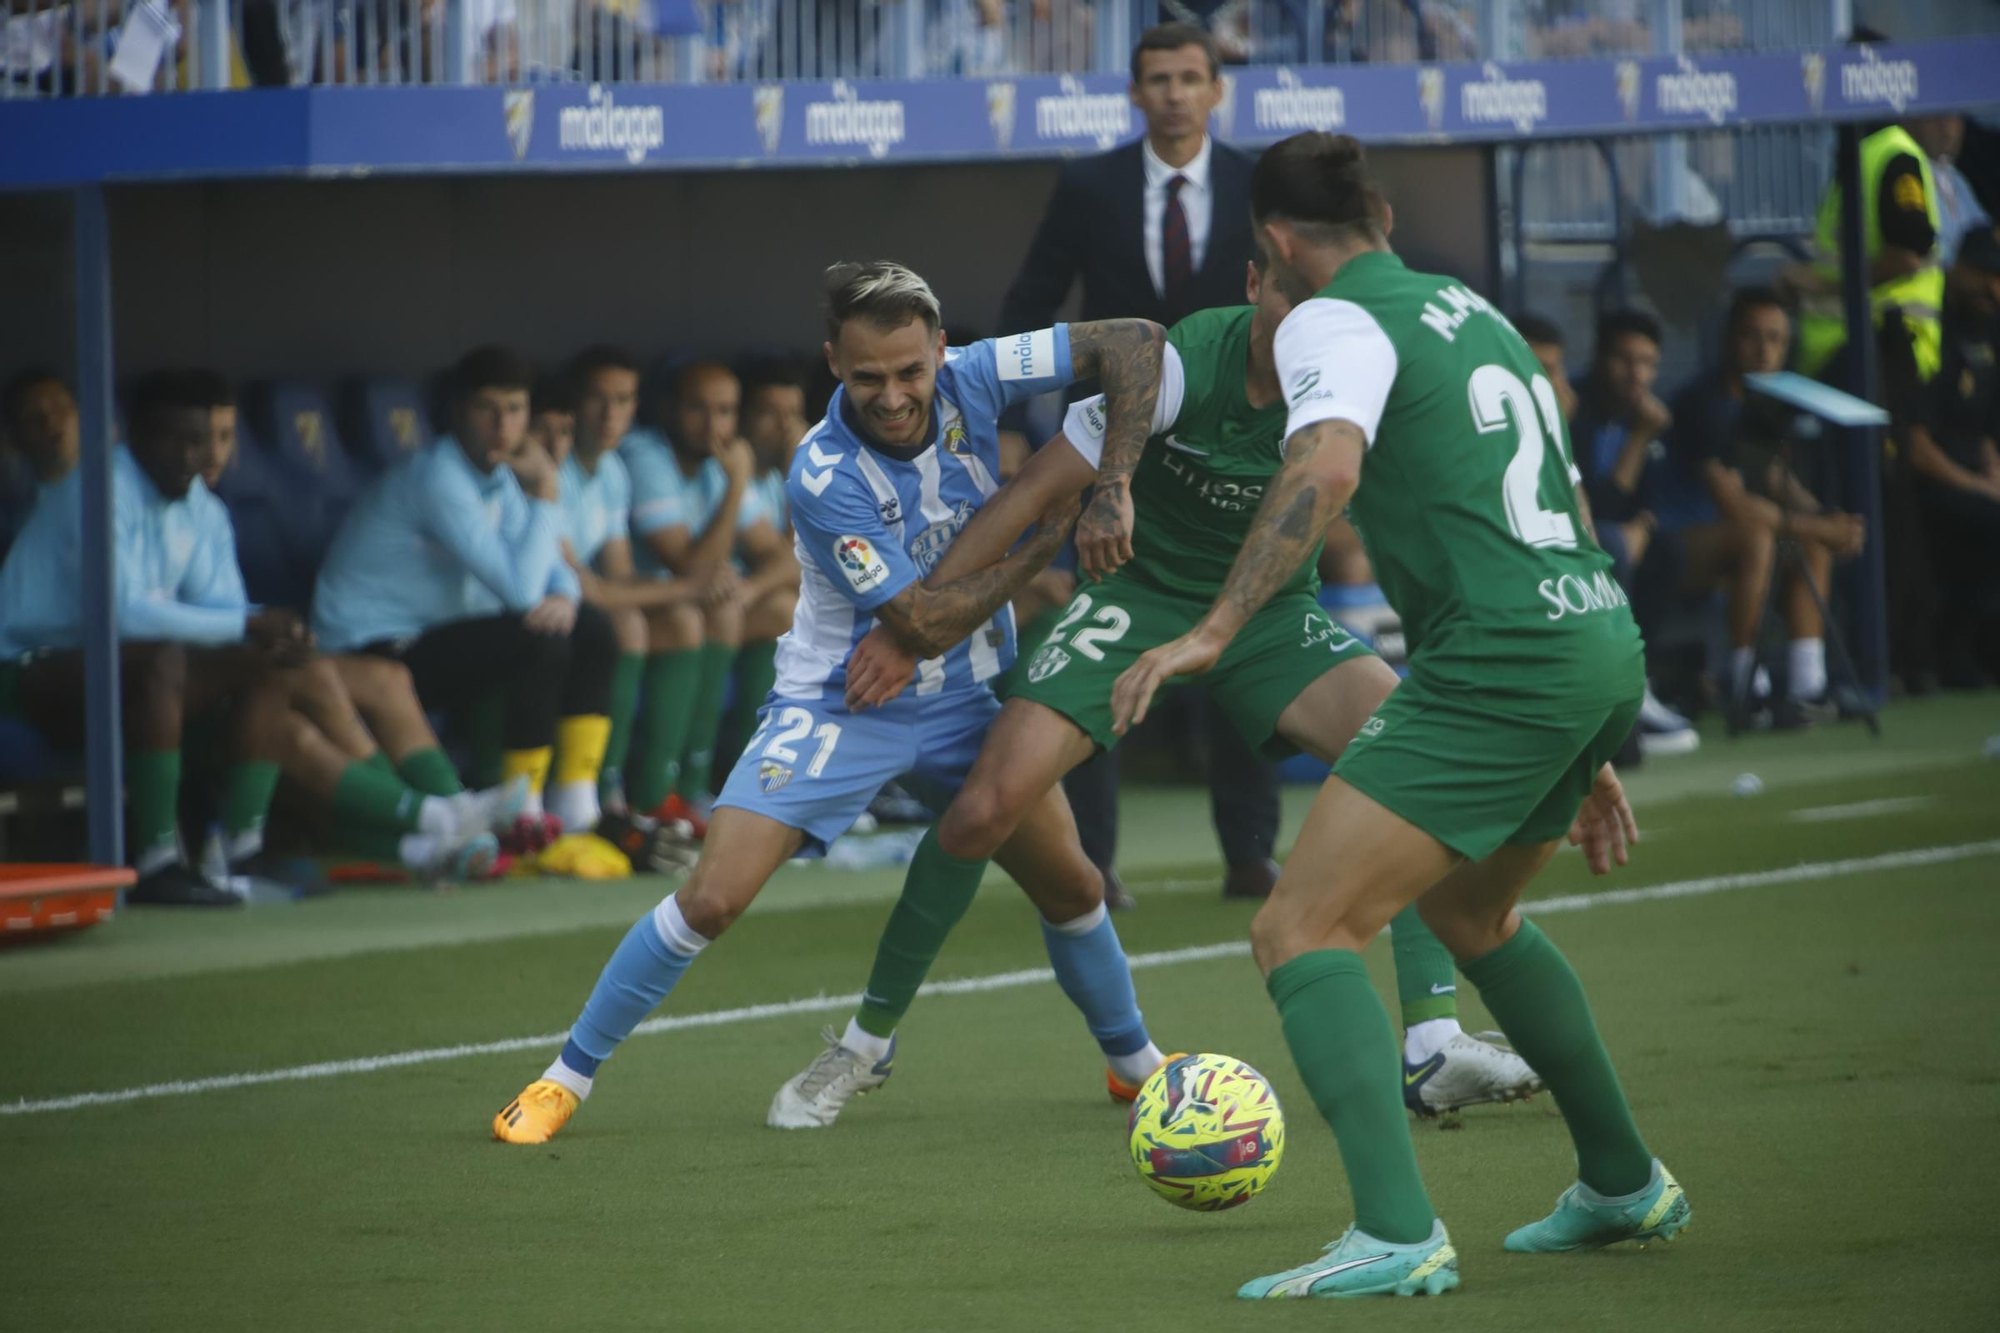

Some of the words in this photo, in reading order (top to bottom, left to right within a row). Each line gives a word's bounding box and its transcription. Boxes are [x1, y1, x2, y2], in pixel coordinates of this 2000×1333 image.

[852, 563, 883, 586] LaLiga
[1043, 593, 1131, 662] 22
[761, 706, 842, 779] 21
